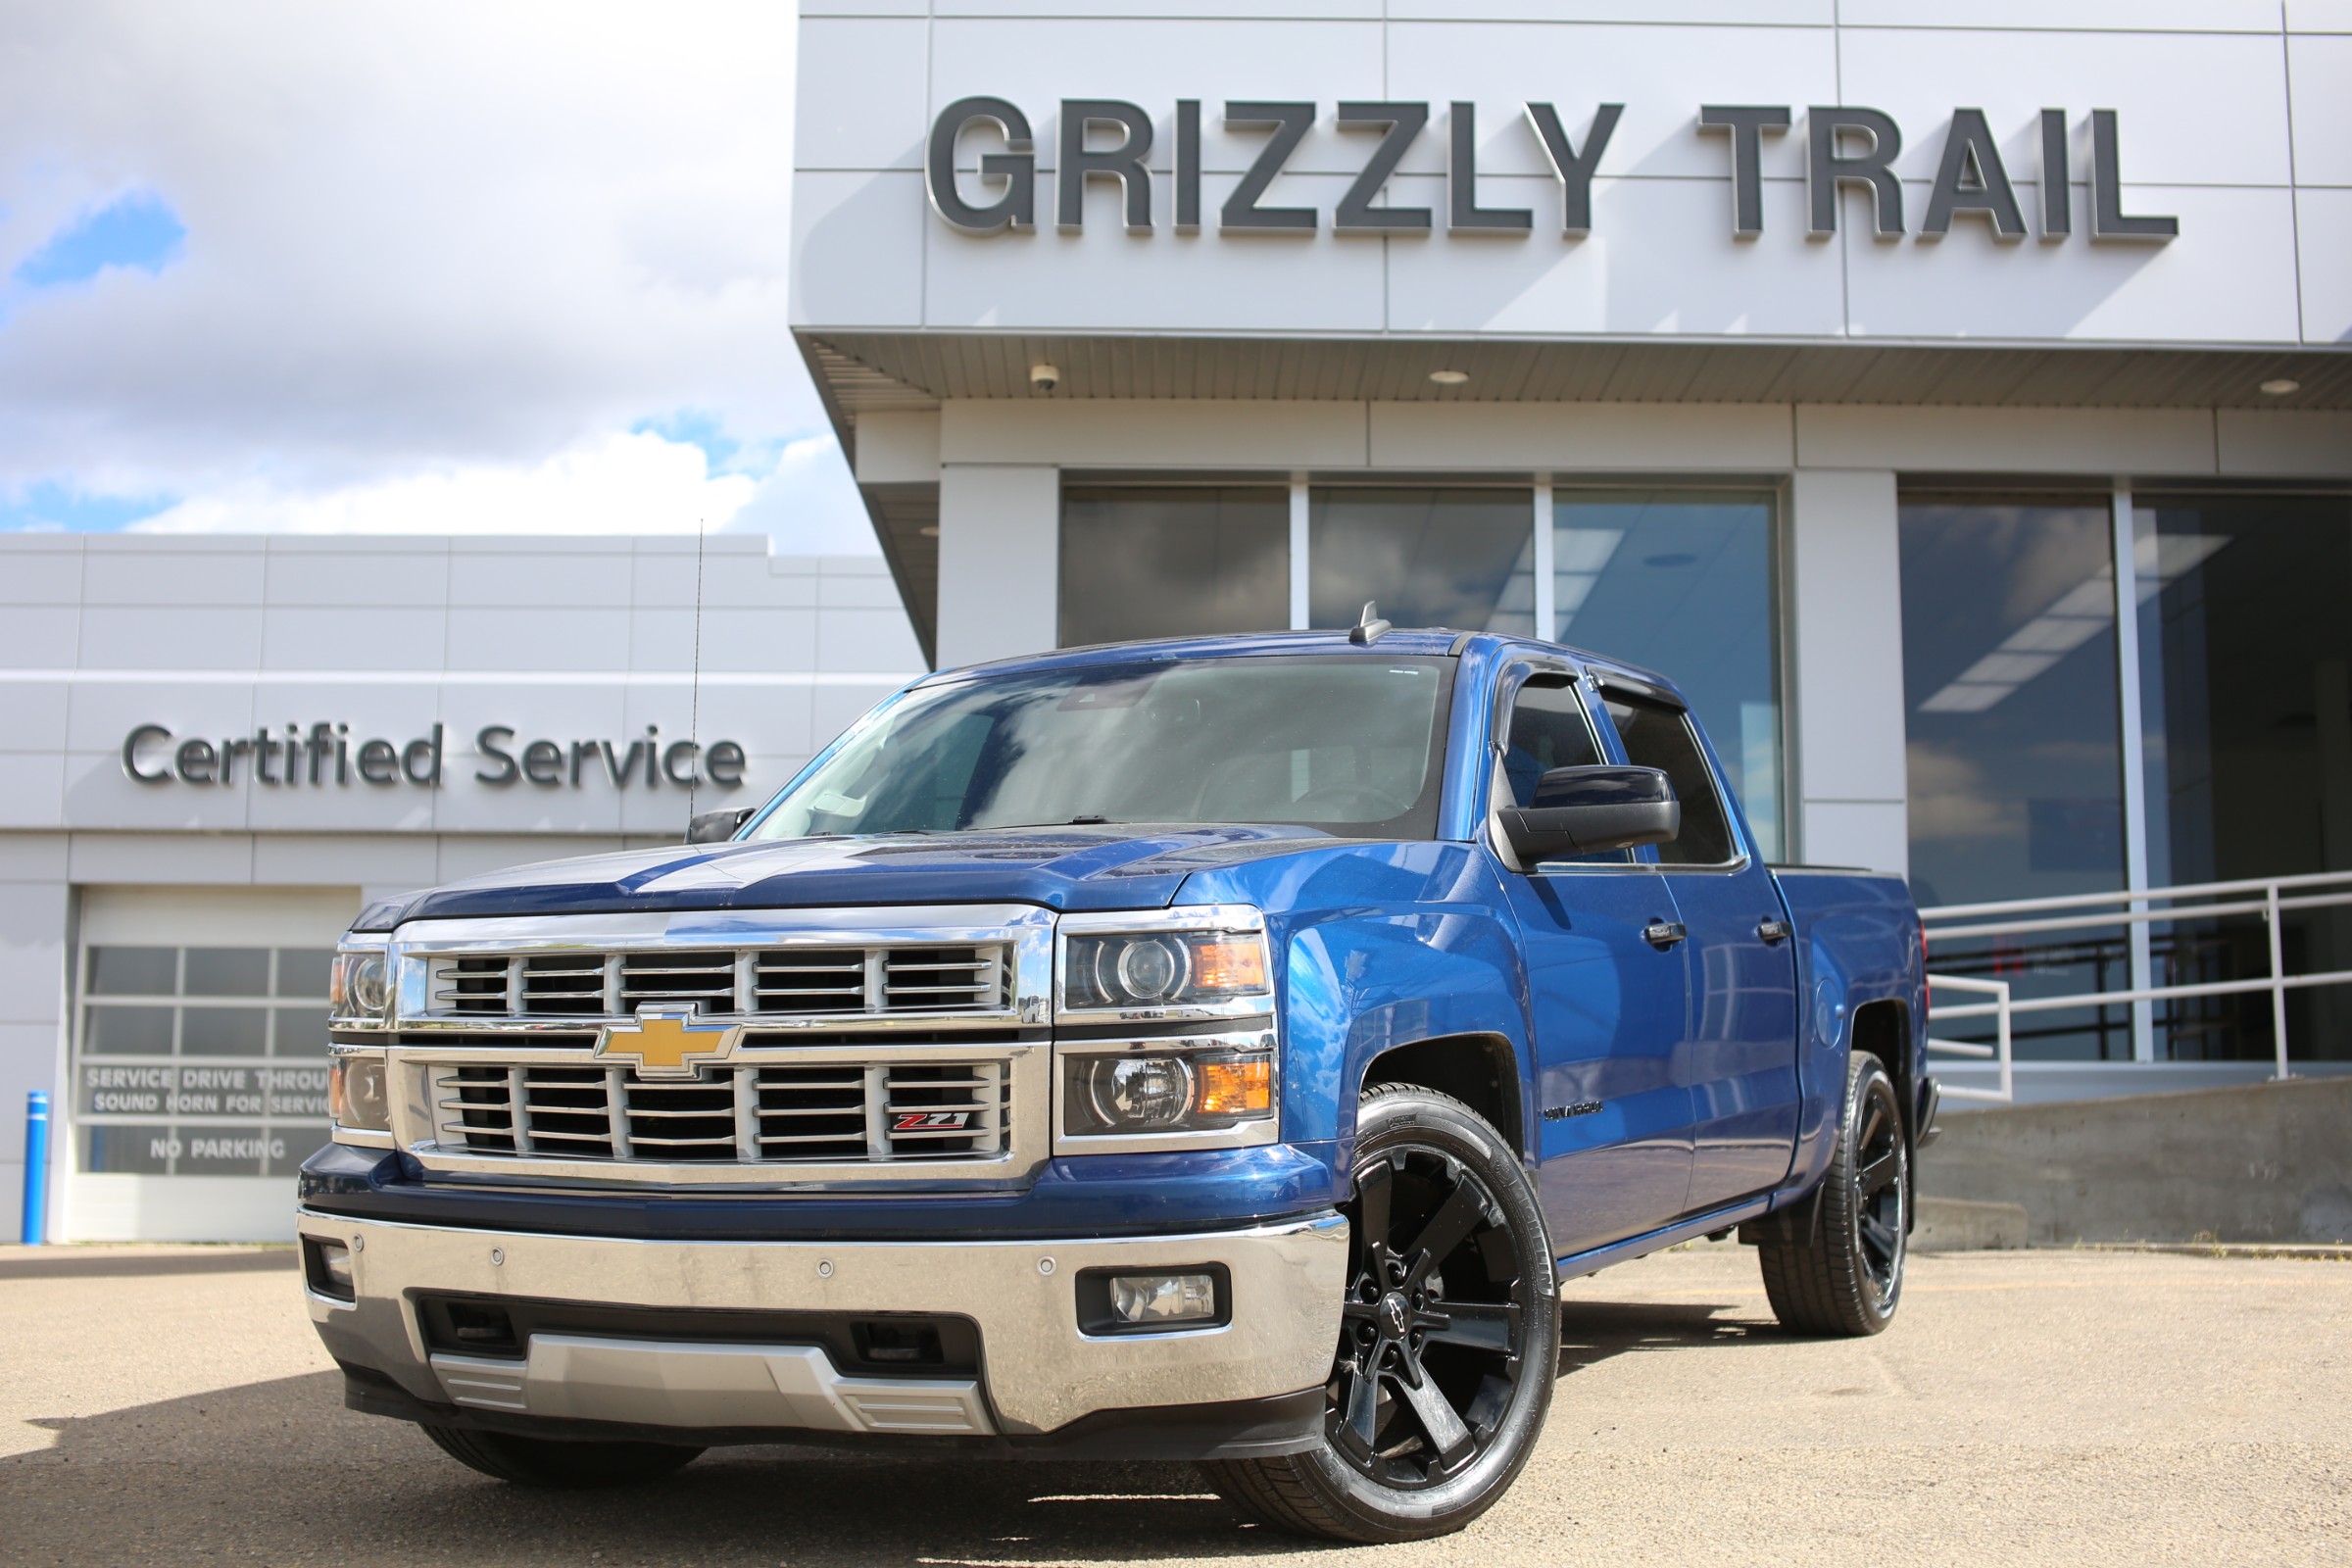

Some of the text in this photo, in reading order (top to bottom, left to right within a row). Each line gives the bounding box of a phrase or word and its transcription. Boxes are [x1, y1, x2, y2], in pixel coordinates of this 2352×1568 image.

[924, 95, 2179, 243] GRIZZLY TRAIL
[121, 722, 747, 788] Certified Service
[86, 1067, 328, 1091] SERVICE DRIVE THROU
[94, 1093, 329, 1114] SOUND HORN FOR SERVIC
[893, 1111, 969, 1130] Z71
[150, 1139, 285, 1160] NO PARKING
